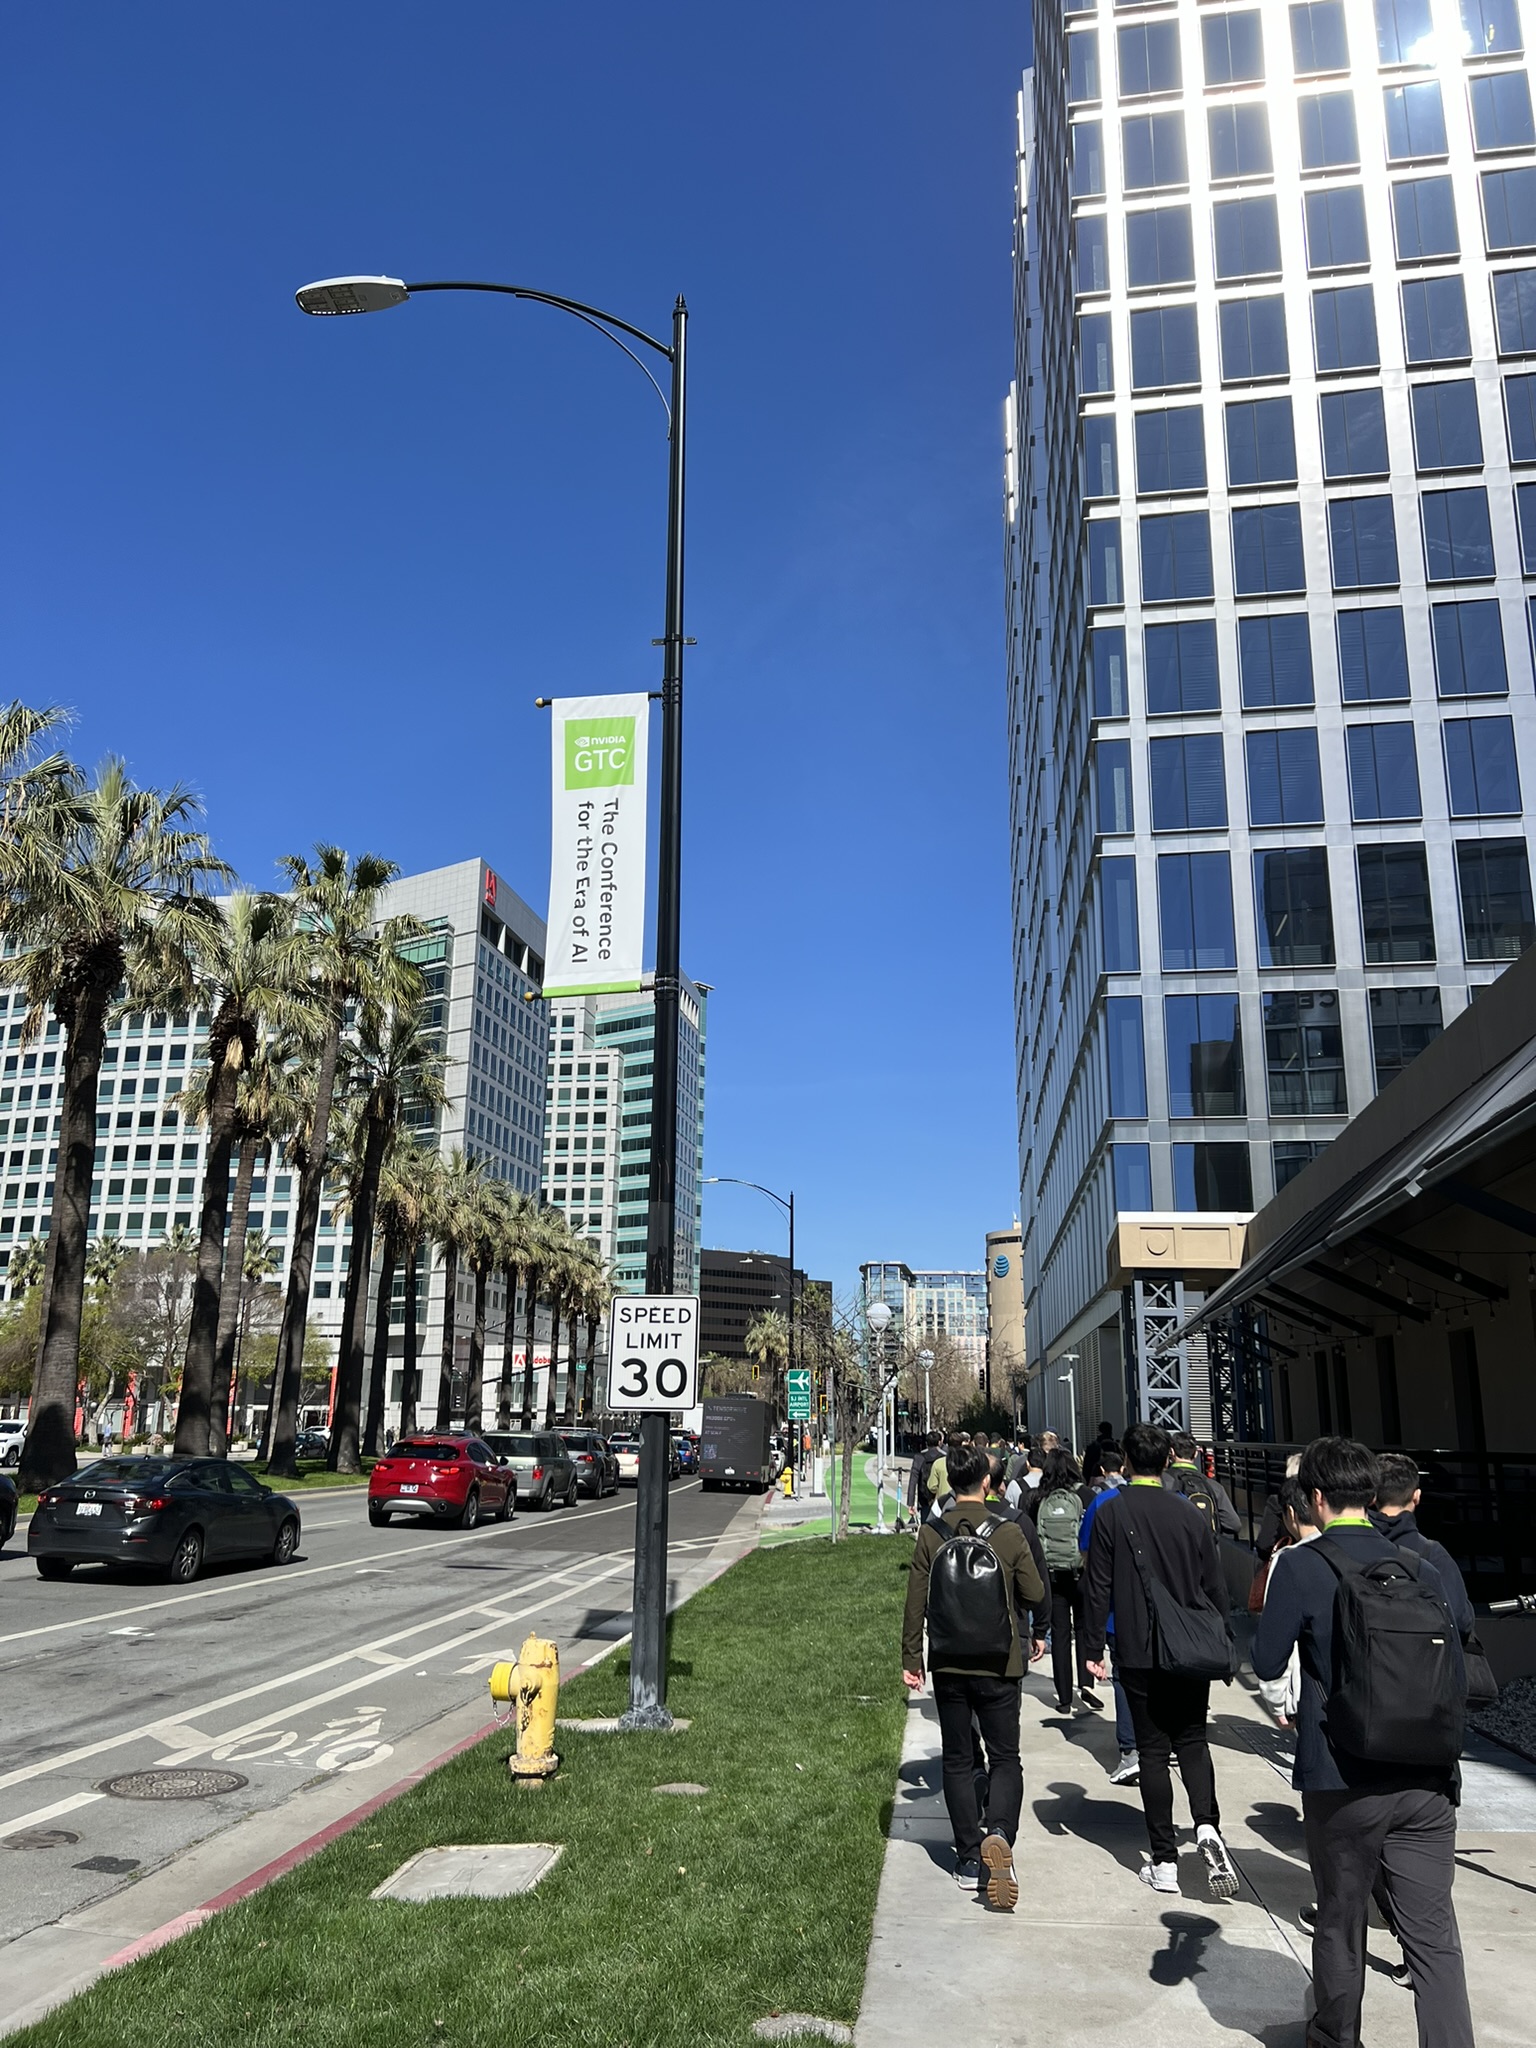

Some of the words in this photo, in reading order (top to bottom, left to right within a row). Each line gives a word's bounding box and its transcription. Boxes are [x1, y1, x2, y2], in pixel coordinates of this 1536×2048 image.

[575, 748, 626, 772] GTC
[578, 800, 594, 830] for
[601, 797, 619, 835] The
[576, 836, 593, 871] the
[574, 876, 590, 909] Era
[598, 842, 618, 960] Conference
[572, 915, 590, 937] of
[571, 943, 588, 963] AI
[619, 1307, 692, 1324] SPEED
[626, 1333, 682, 1349] LIMIT
[618, 1358, 688, 1398] 30
